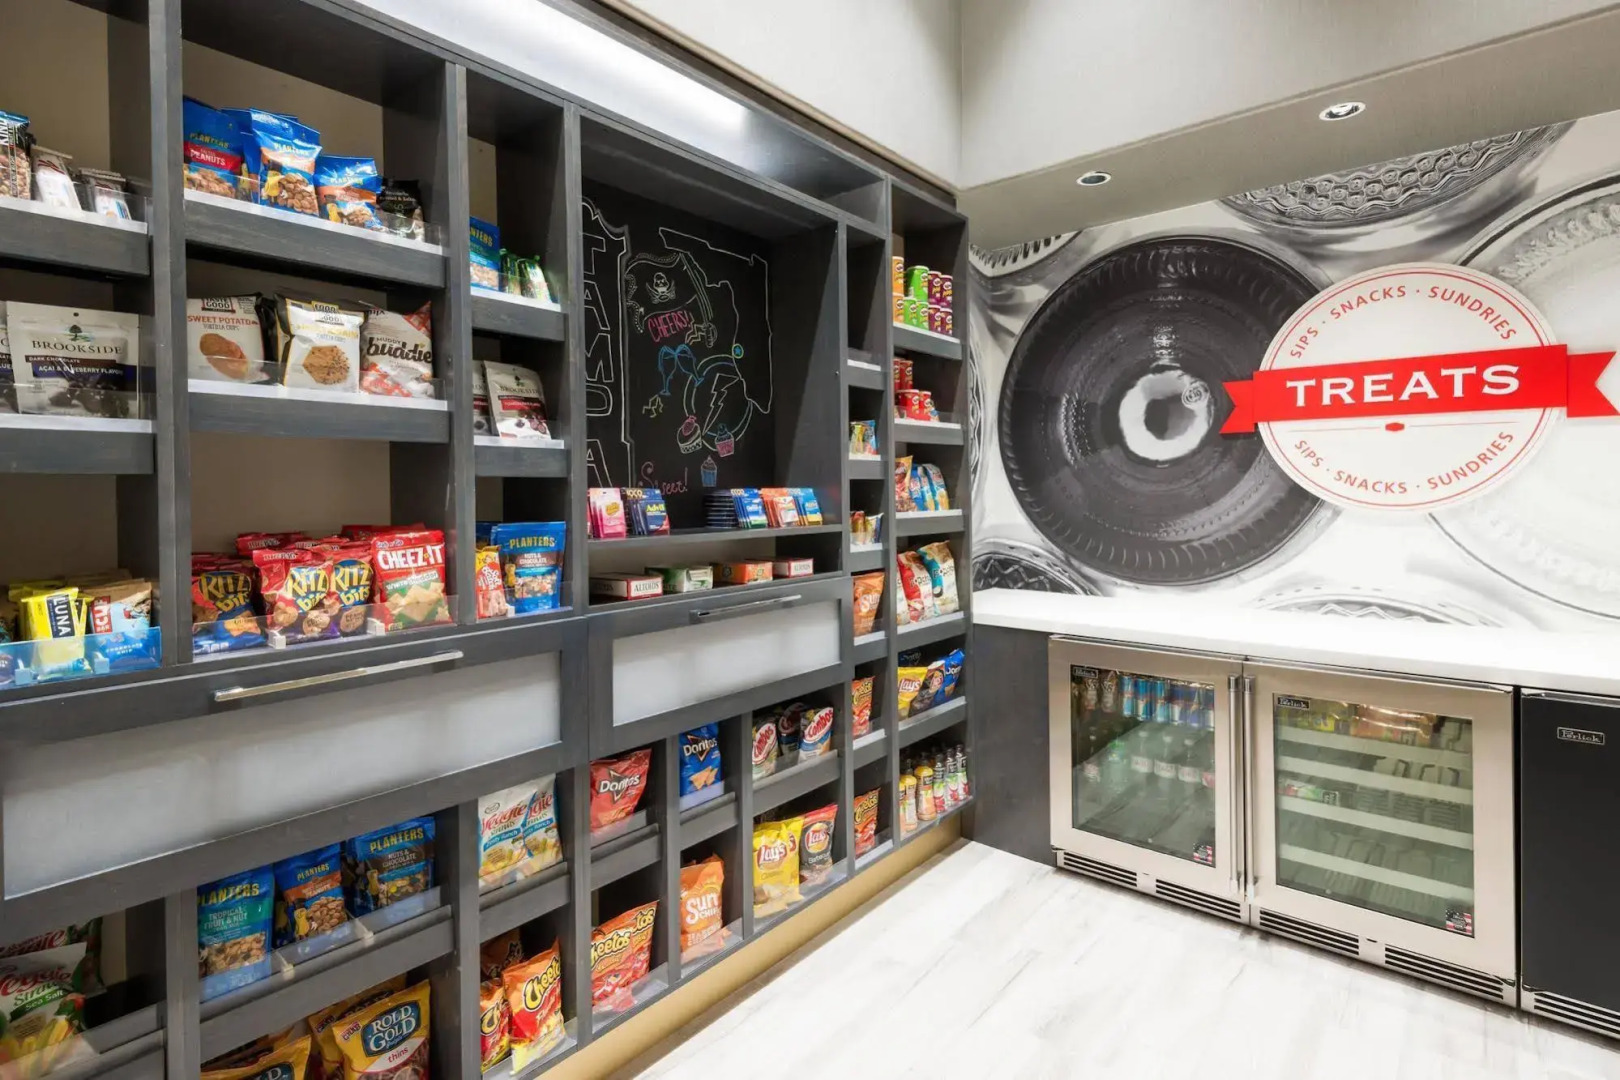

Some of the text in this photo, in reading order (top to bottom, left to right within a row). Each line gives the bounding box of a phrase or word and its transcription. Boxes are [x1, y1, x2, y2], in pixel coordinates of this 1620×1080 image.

[190, 132, 229, 149] PLANTERS
[190, 149, 226, 166] PEANUTS
[187, 315, 251, 325] SWEET POTATO
[648, 310, 689, 343] CHEERS!
[1290, 285, 1517, 360] SIPS SNACKS SUNDRIES
[32, 340, 123, 354] BROOKSIDE
[366, 336, 433, 363] buddie
[63, 366, 100, 374] BLUEBERRY
[1286, 364, 1521, 407] TREATS
[1294, 431, 1515, 495] SIPS SNACKS SUNDRIES
[640, 461, 688, 496] Seet!
[645, 503, 666, 512] Advil
[509, 536, 556, 549] PLANTERS
[377, 542, 444, 570] CHEEZ-IT
[199, 572, 252, 600] RITZ
[284, 567, 329, 599] RITZ
[331, 562, 372, 593] RITZ
[634, 581, 660, 592] ALTOIDS
[52, 598, 72, 635] LUNA
[683, 737, 718, 757] Doritos
[1562, 730, 1601, 743] Perlick
[600, 774, 640, 793] Doritos
[854, 795, 878, 824] Cheetos
[369, 827, 424, 853] PLANTERS
[297, 863, 330, 881] PLANTERS
[382, 853, 416, 868] CHOCOLATE
[204, 918, 225, 930] FRUIT
[233, 912, 248, 923] NUT
[208, 906, 243, 921] TROPICAL
[686, 893, 719, 925] Sun
[591, 931, 631, 966] heetos
[524, 956, 561, 1011] Cheet
[25, 989, 63, 1010] Sea Salt
[371, 1005, 412, 1033] ROLD
[369, 1017, 416, 1051] GOLD
[387, 1047, 409, 1062] thins
